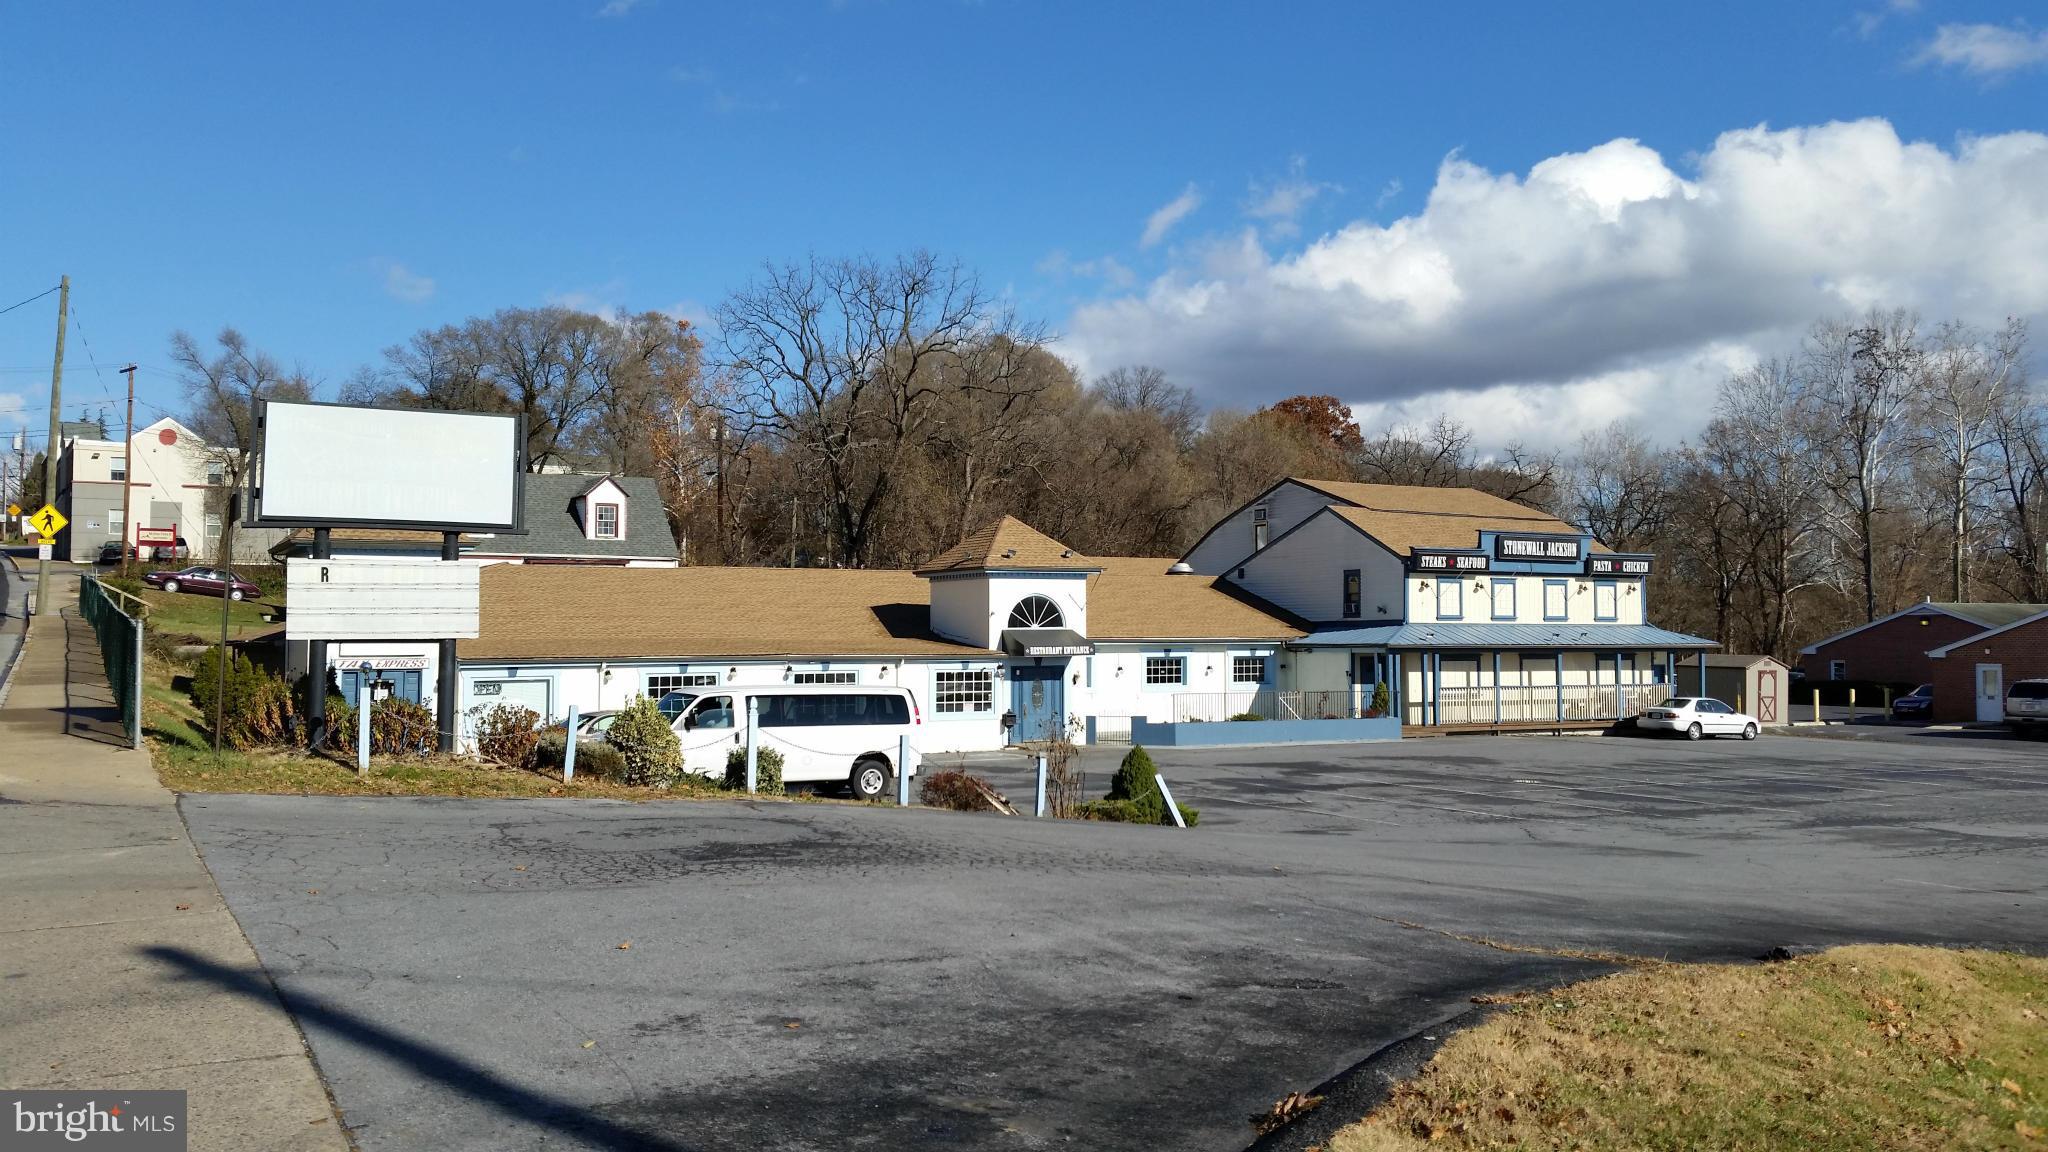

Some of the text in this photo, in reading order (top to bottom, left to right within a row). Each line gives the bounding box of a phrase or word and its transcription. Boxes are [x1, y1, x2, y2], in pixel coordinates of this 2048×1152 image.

[1503, 540, 1578, 557] STONEWALL JACKSON
[1421, 555, 1486, 569] STEAKS SEAFOOD
[1593, 560, 1649, 573] PASTA CHICKEN
[320, 566, 329, 583] R
[1030, 645, 1090, 655] RESTAURANT ENTRANCE
[375, 659, 427, 668] EXPRESS
